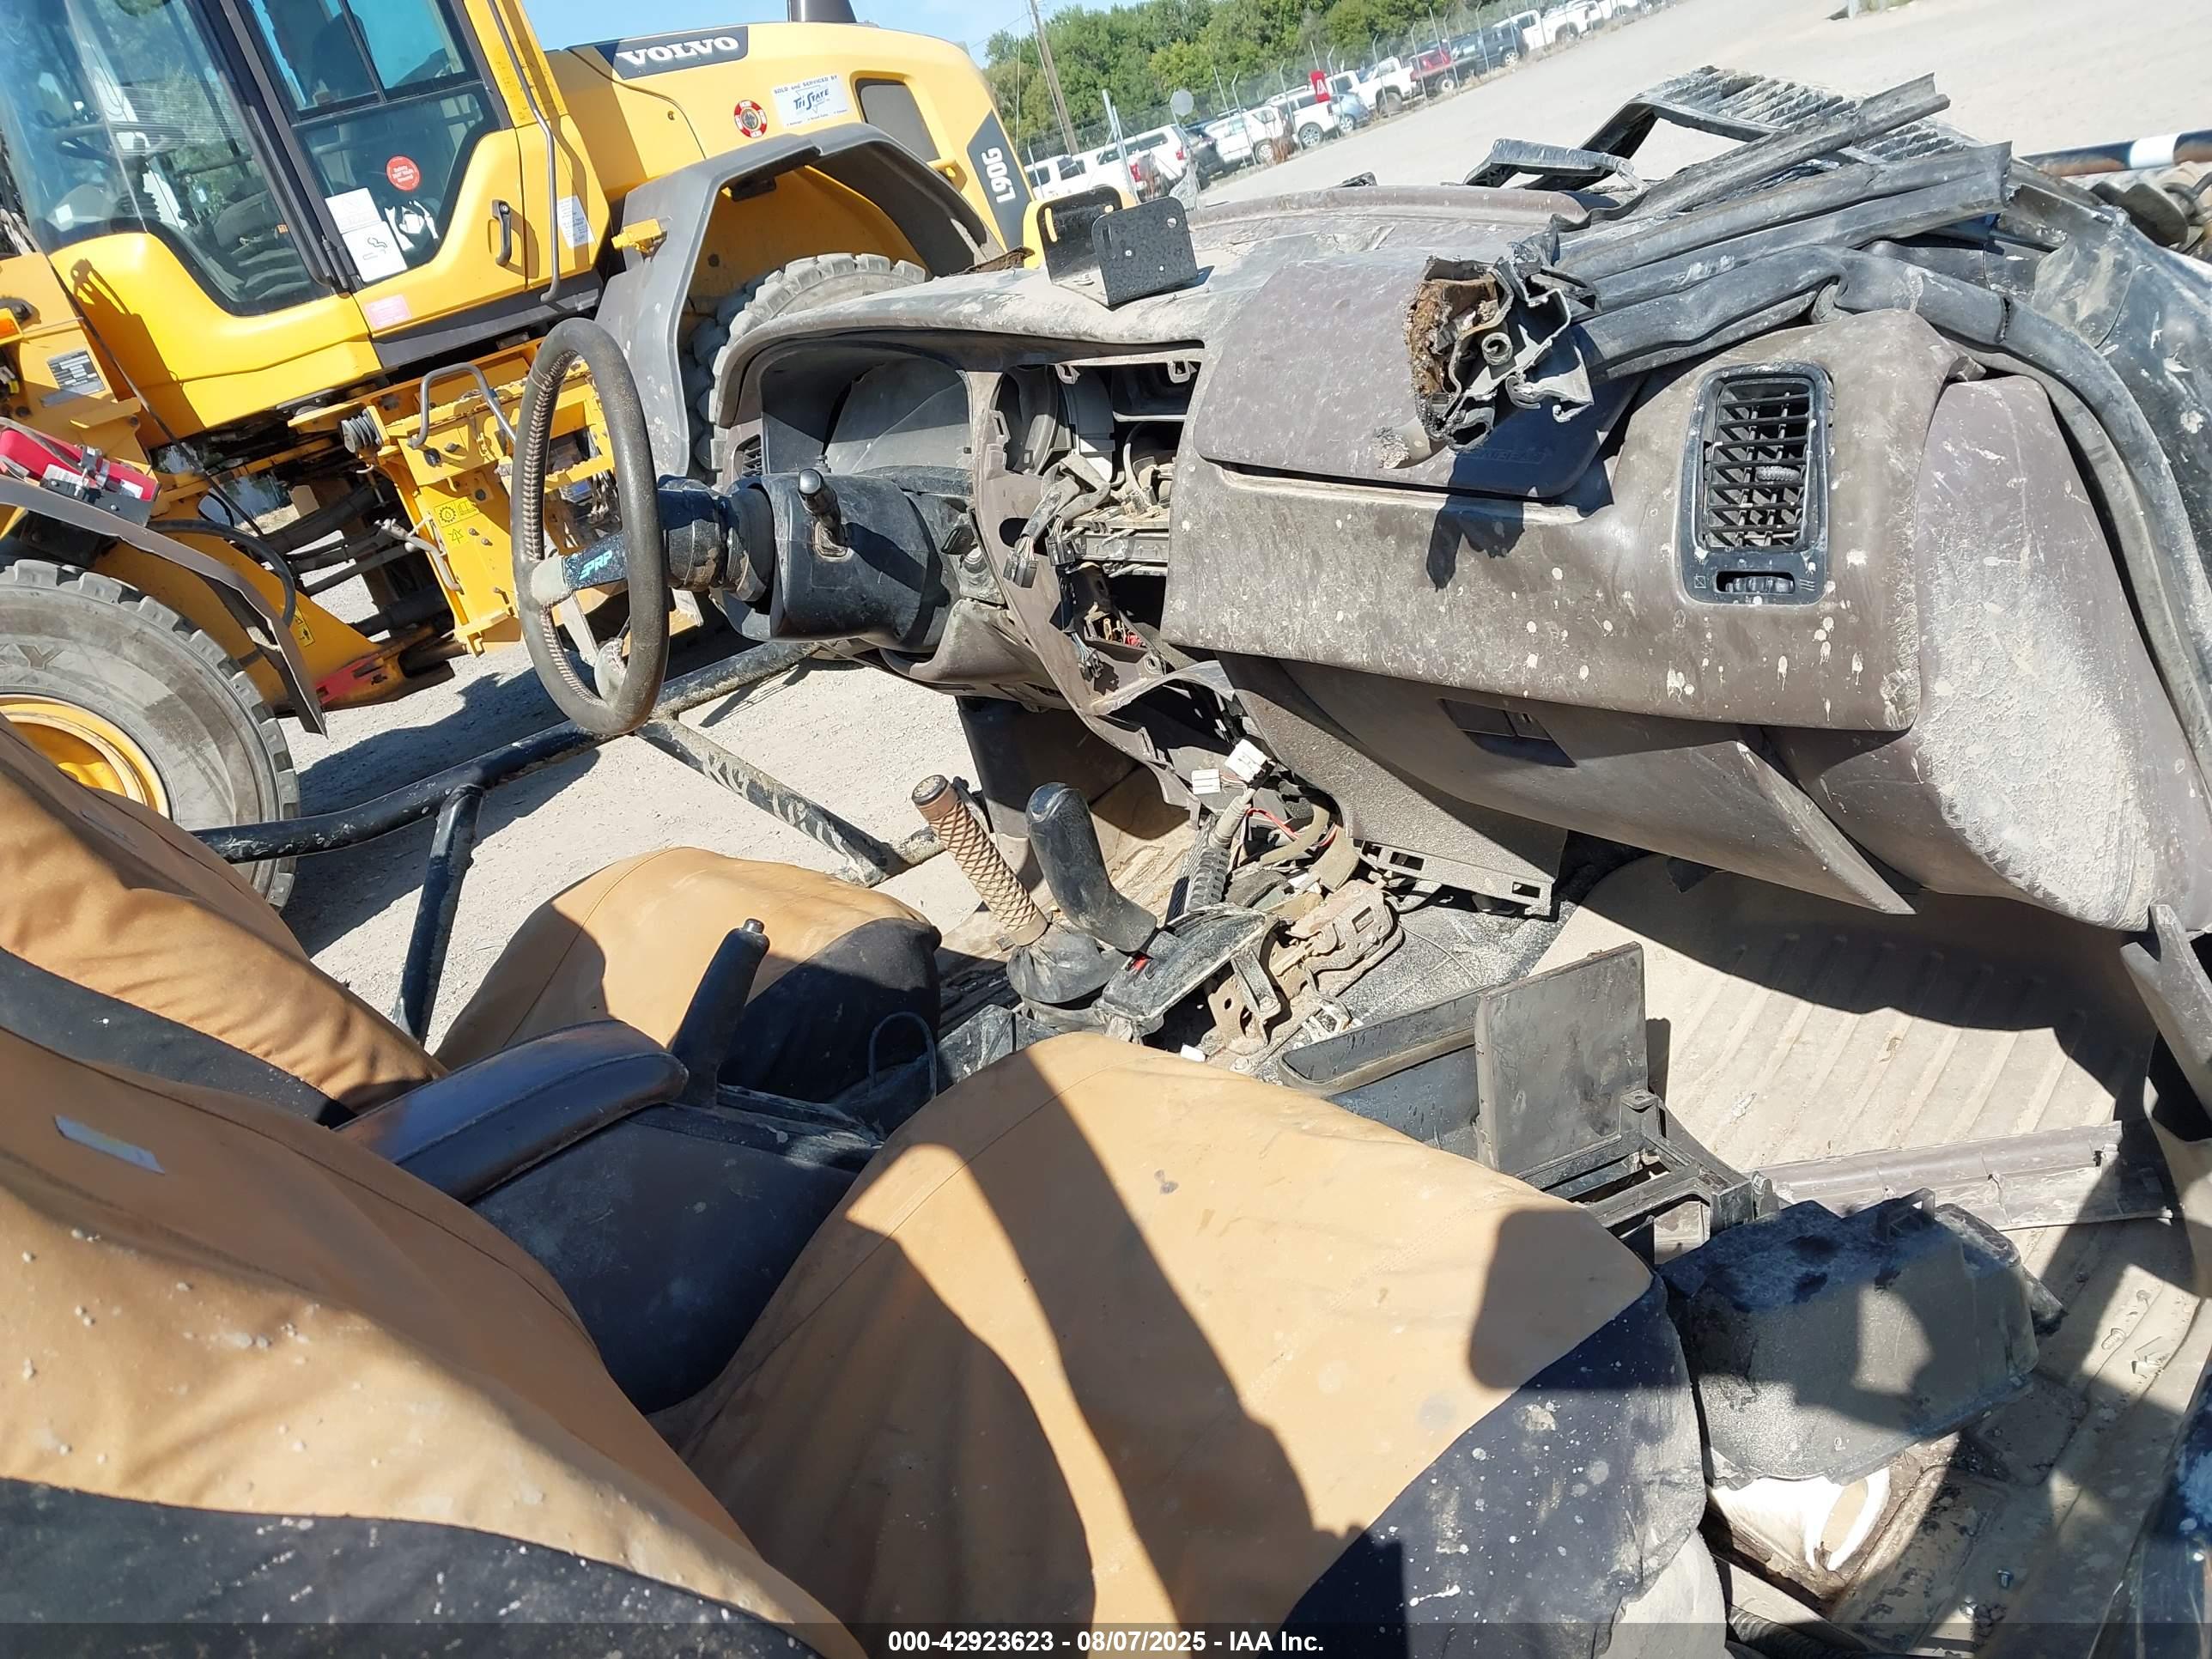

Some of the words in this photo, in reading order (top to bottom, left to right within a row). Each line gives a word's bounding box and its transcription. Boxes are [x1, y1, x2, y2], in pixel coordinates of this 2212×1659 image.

[616, 36, 739, 66] VOLVO
[802, 76, 829, 88] SERVICED
[981, 147, 1016, 204] L90G
